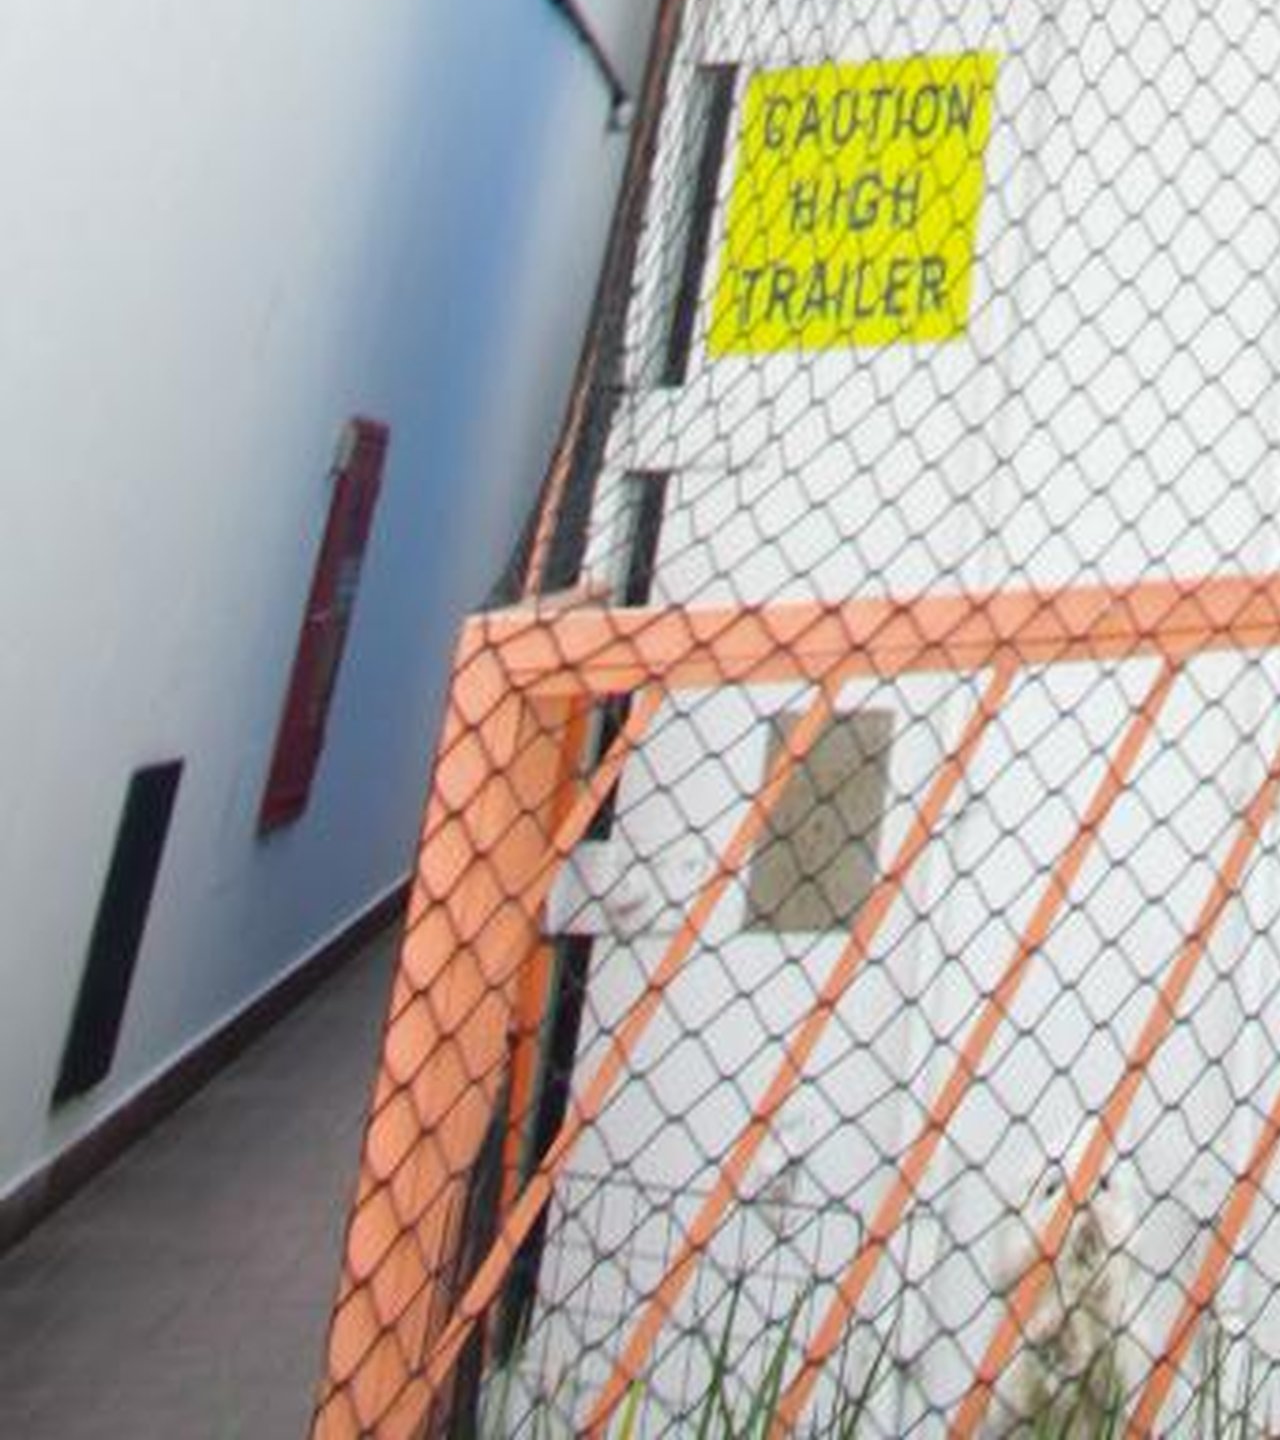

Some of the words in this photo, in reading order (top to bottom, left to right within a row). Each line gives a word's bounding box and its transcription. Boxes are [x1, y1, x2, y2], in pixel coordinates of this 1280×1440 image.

[764, 81, 976, 150] CAUTION
[790, 172, 922, 233] HIGH
[738, 253, 948, 325] TRAILER
